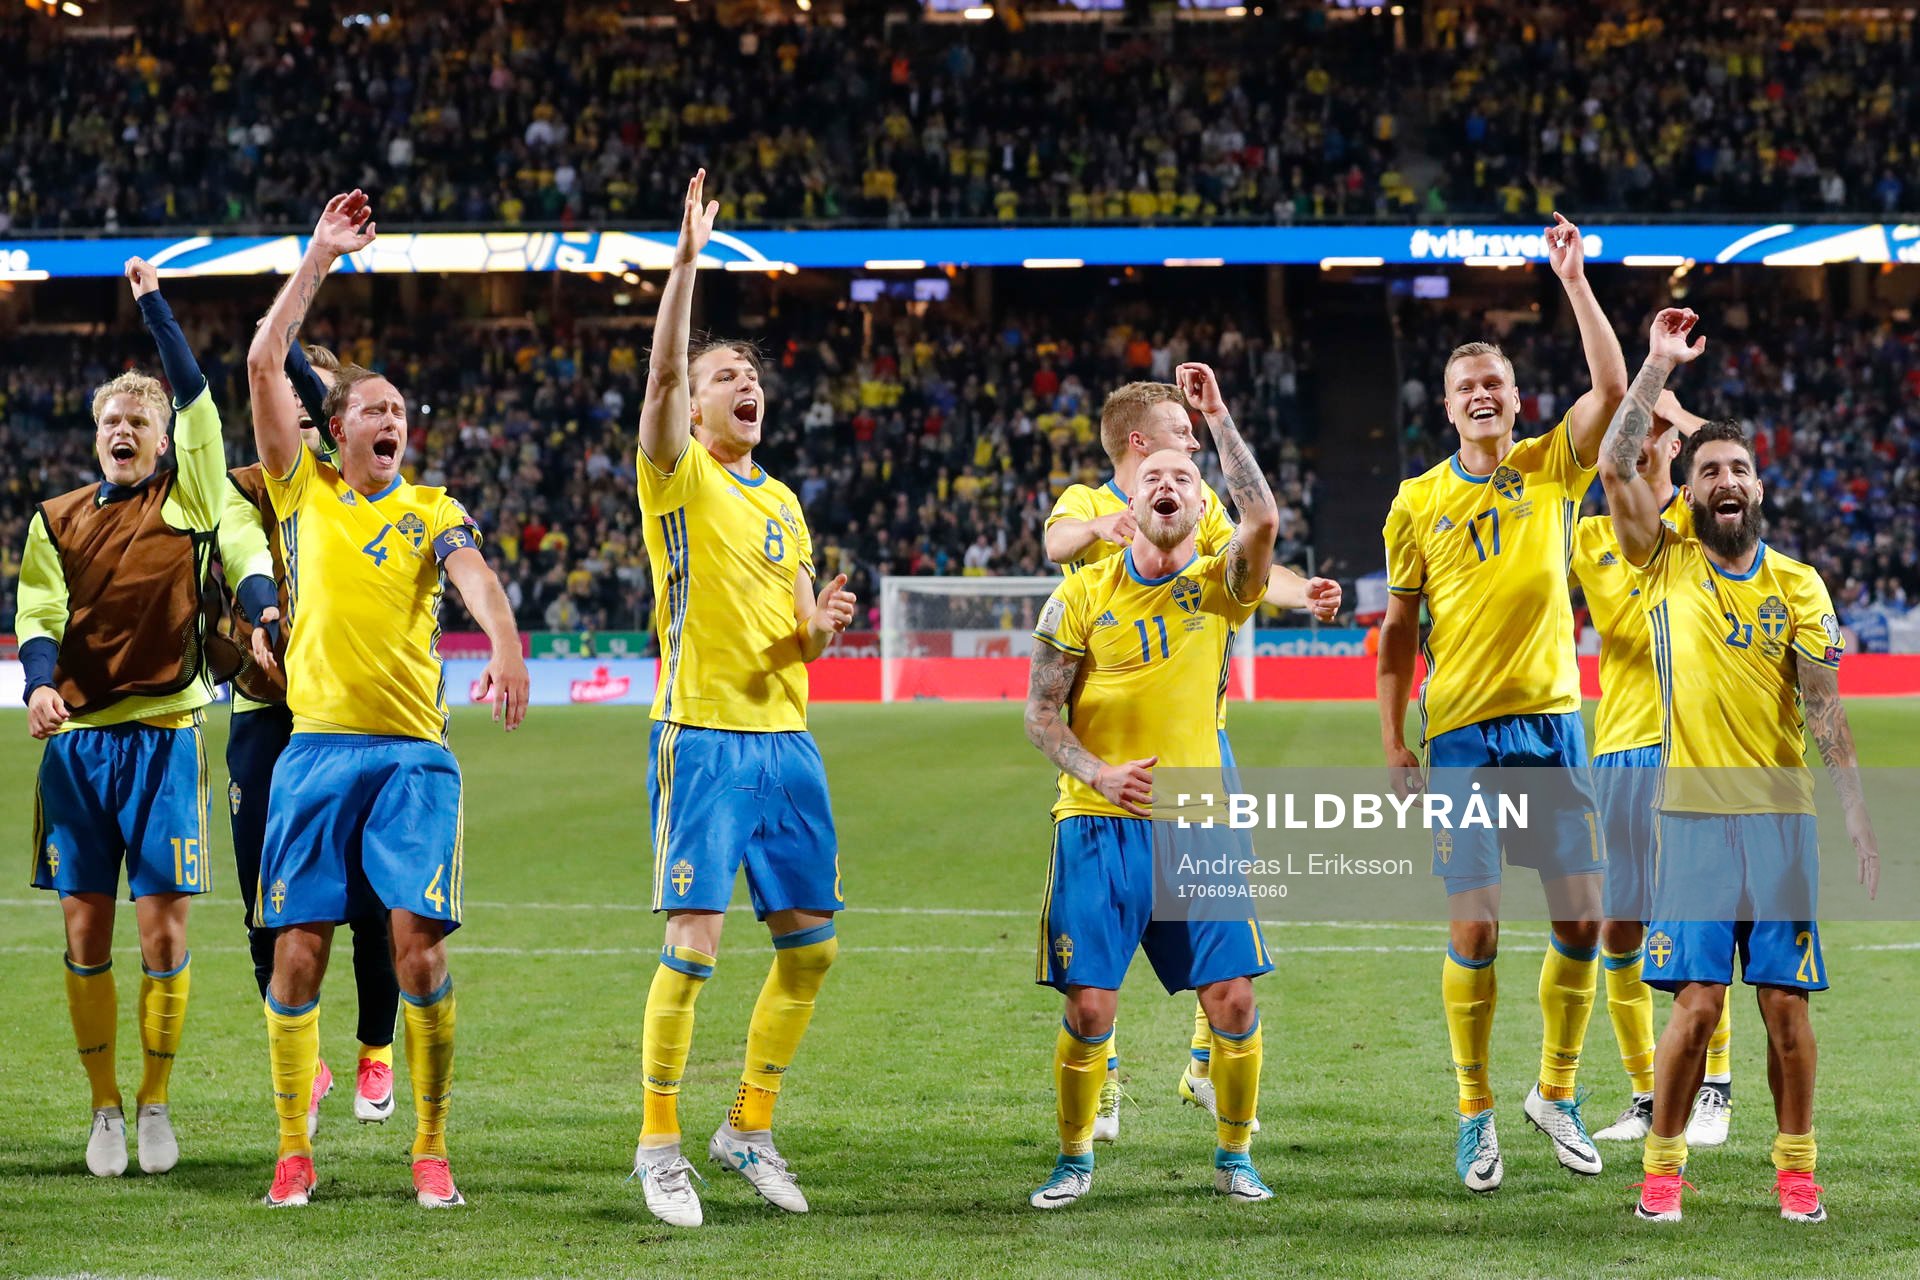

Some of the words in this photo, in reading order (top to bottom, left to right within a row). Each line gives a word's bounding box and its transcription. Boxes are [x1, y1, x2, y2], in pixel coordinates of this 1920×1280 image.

[362, 523, 393, 567] 4
[764, 518, 784, 562] 8
[1466, 506, 1500, 562] 17
[1134, 615, 1169, 663] 11
[1725, 612, 1753, 650] 21
[170, 837, 198, 886] 15
[424, 863, 446, 913] 4
[1795, 930, 1819, 983] 21
